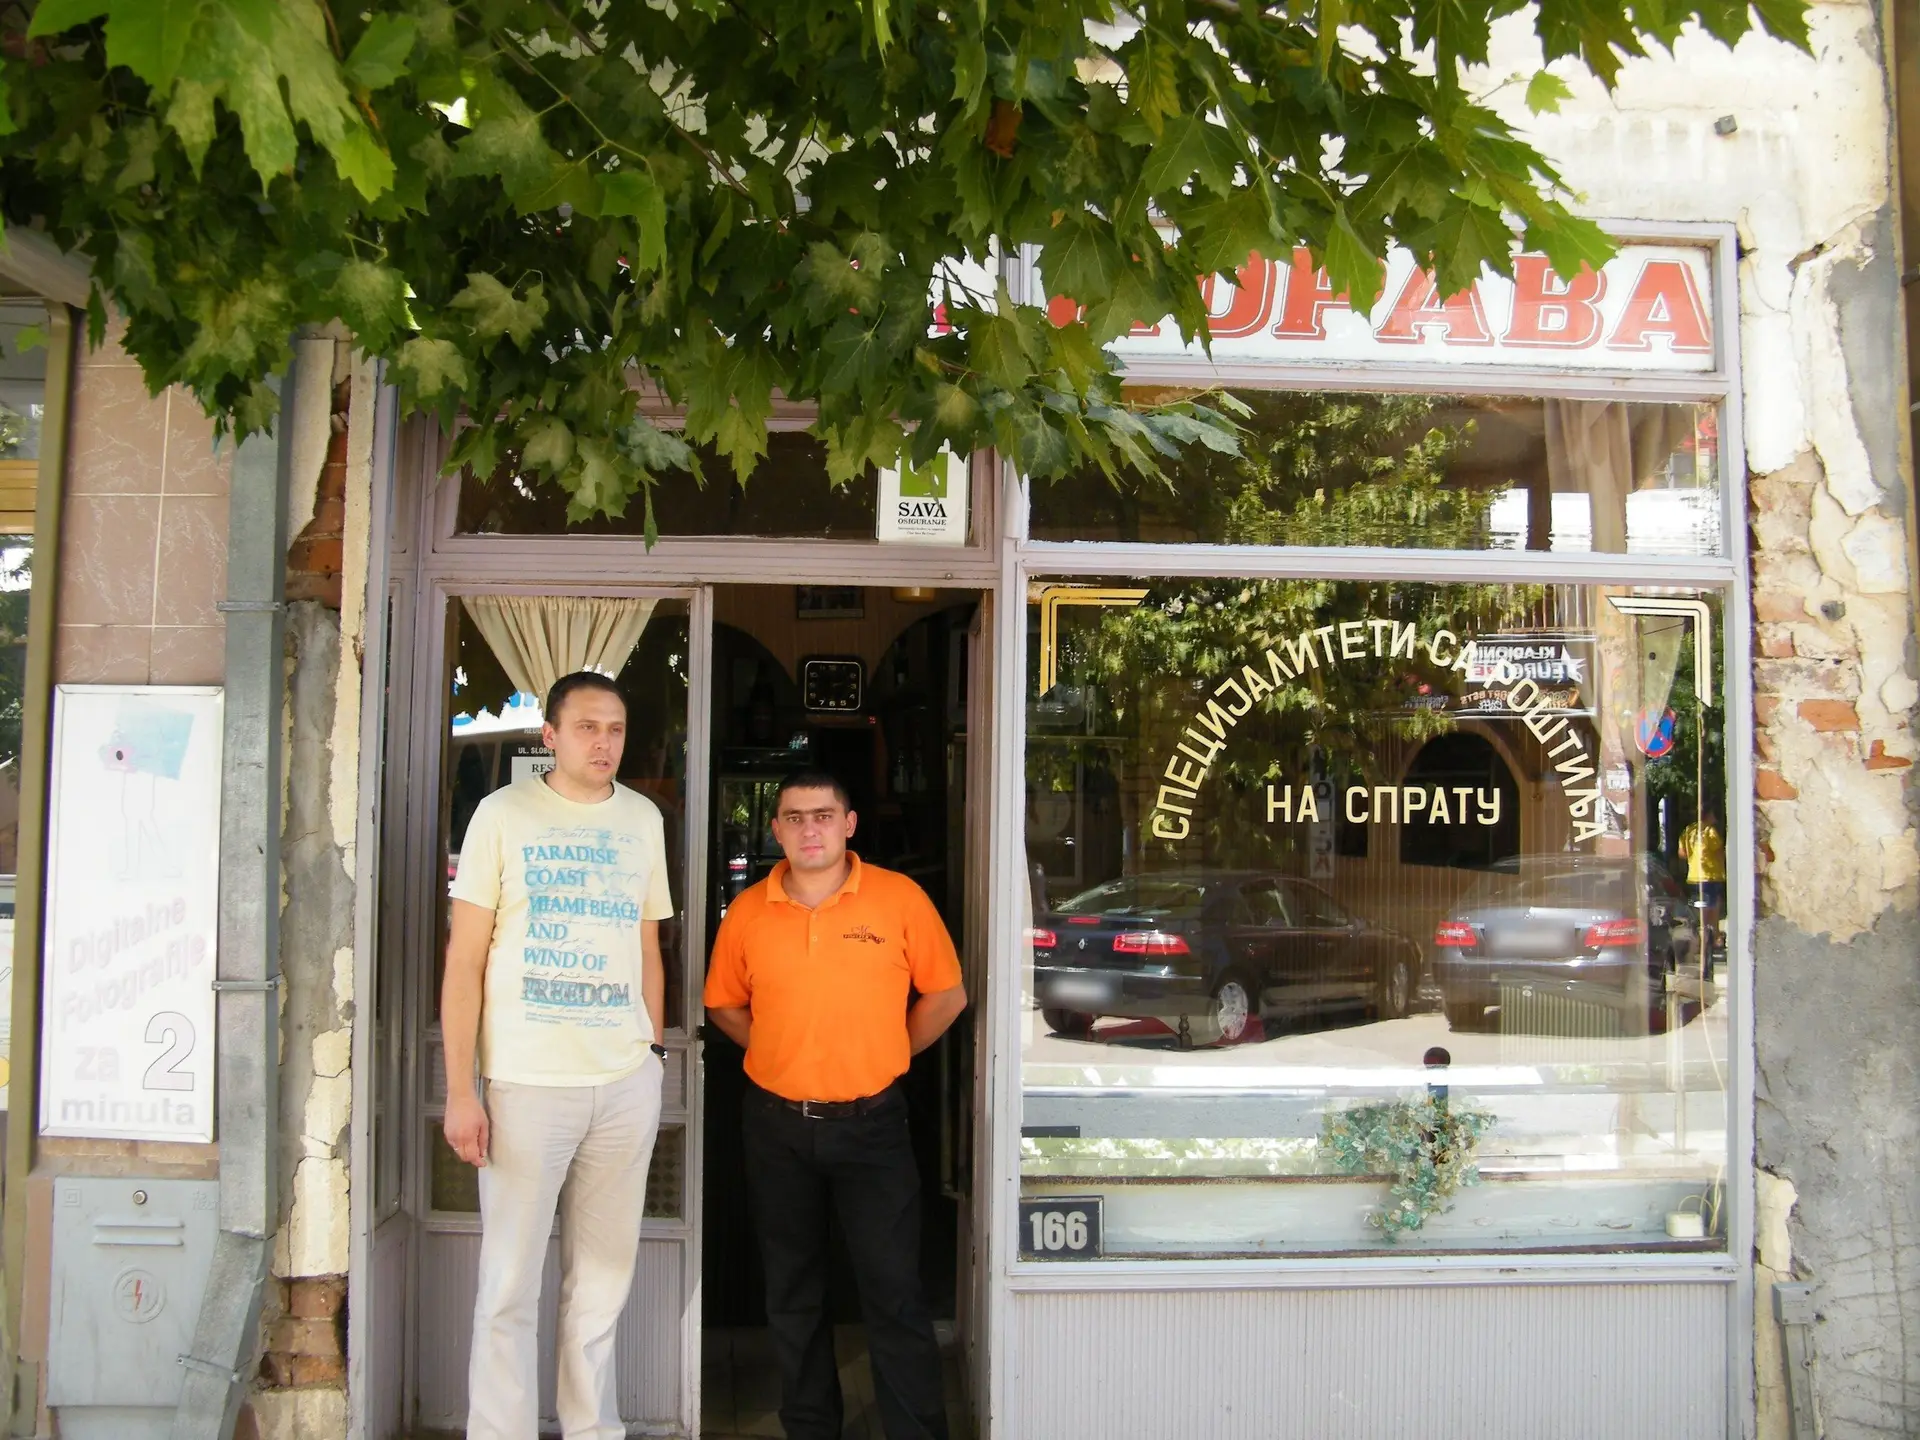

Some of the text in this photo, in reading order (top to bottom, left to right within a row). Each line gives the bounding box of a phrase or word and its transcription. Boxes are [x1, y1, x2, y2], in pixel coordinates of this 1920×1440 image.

[1046, 244, 1712, 354] ОРАВА
[897, 518, 947, 526] OSIGURANJE
[898, 501, 947, 518] SAVA
[1152, 619, 1416, 841] СПЕЦИЈАЛИТЕТИ
[1430, 629, 1478, 681] СА
[1483, 657, 1608, 843] РОШТИЉА
[530, 747, 554, 755] SLOBO
[531, 763, 557, 774] RES
[1267, 784, 1500, 826] НА СПРАТУ
[522, 845, 619, 865] PARADISE
[524, 867, 589, 888] COAST
[527, 895, 640, 921] MIAMI BEACH
[69, 896, 187, 975] Digitalne
[525, 922, 568, 941] AND
[523, 947, 608, 971] WIND OF
[521, 976, 631, 1007] FREEDOM
[74, 1011, 196, 1092] za 2
[60, 1092, 196, 1126] minuta
[1029, 1210, 1088, 1251] 166
